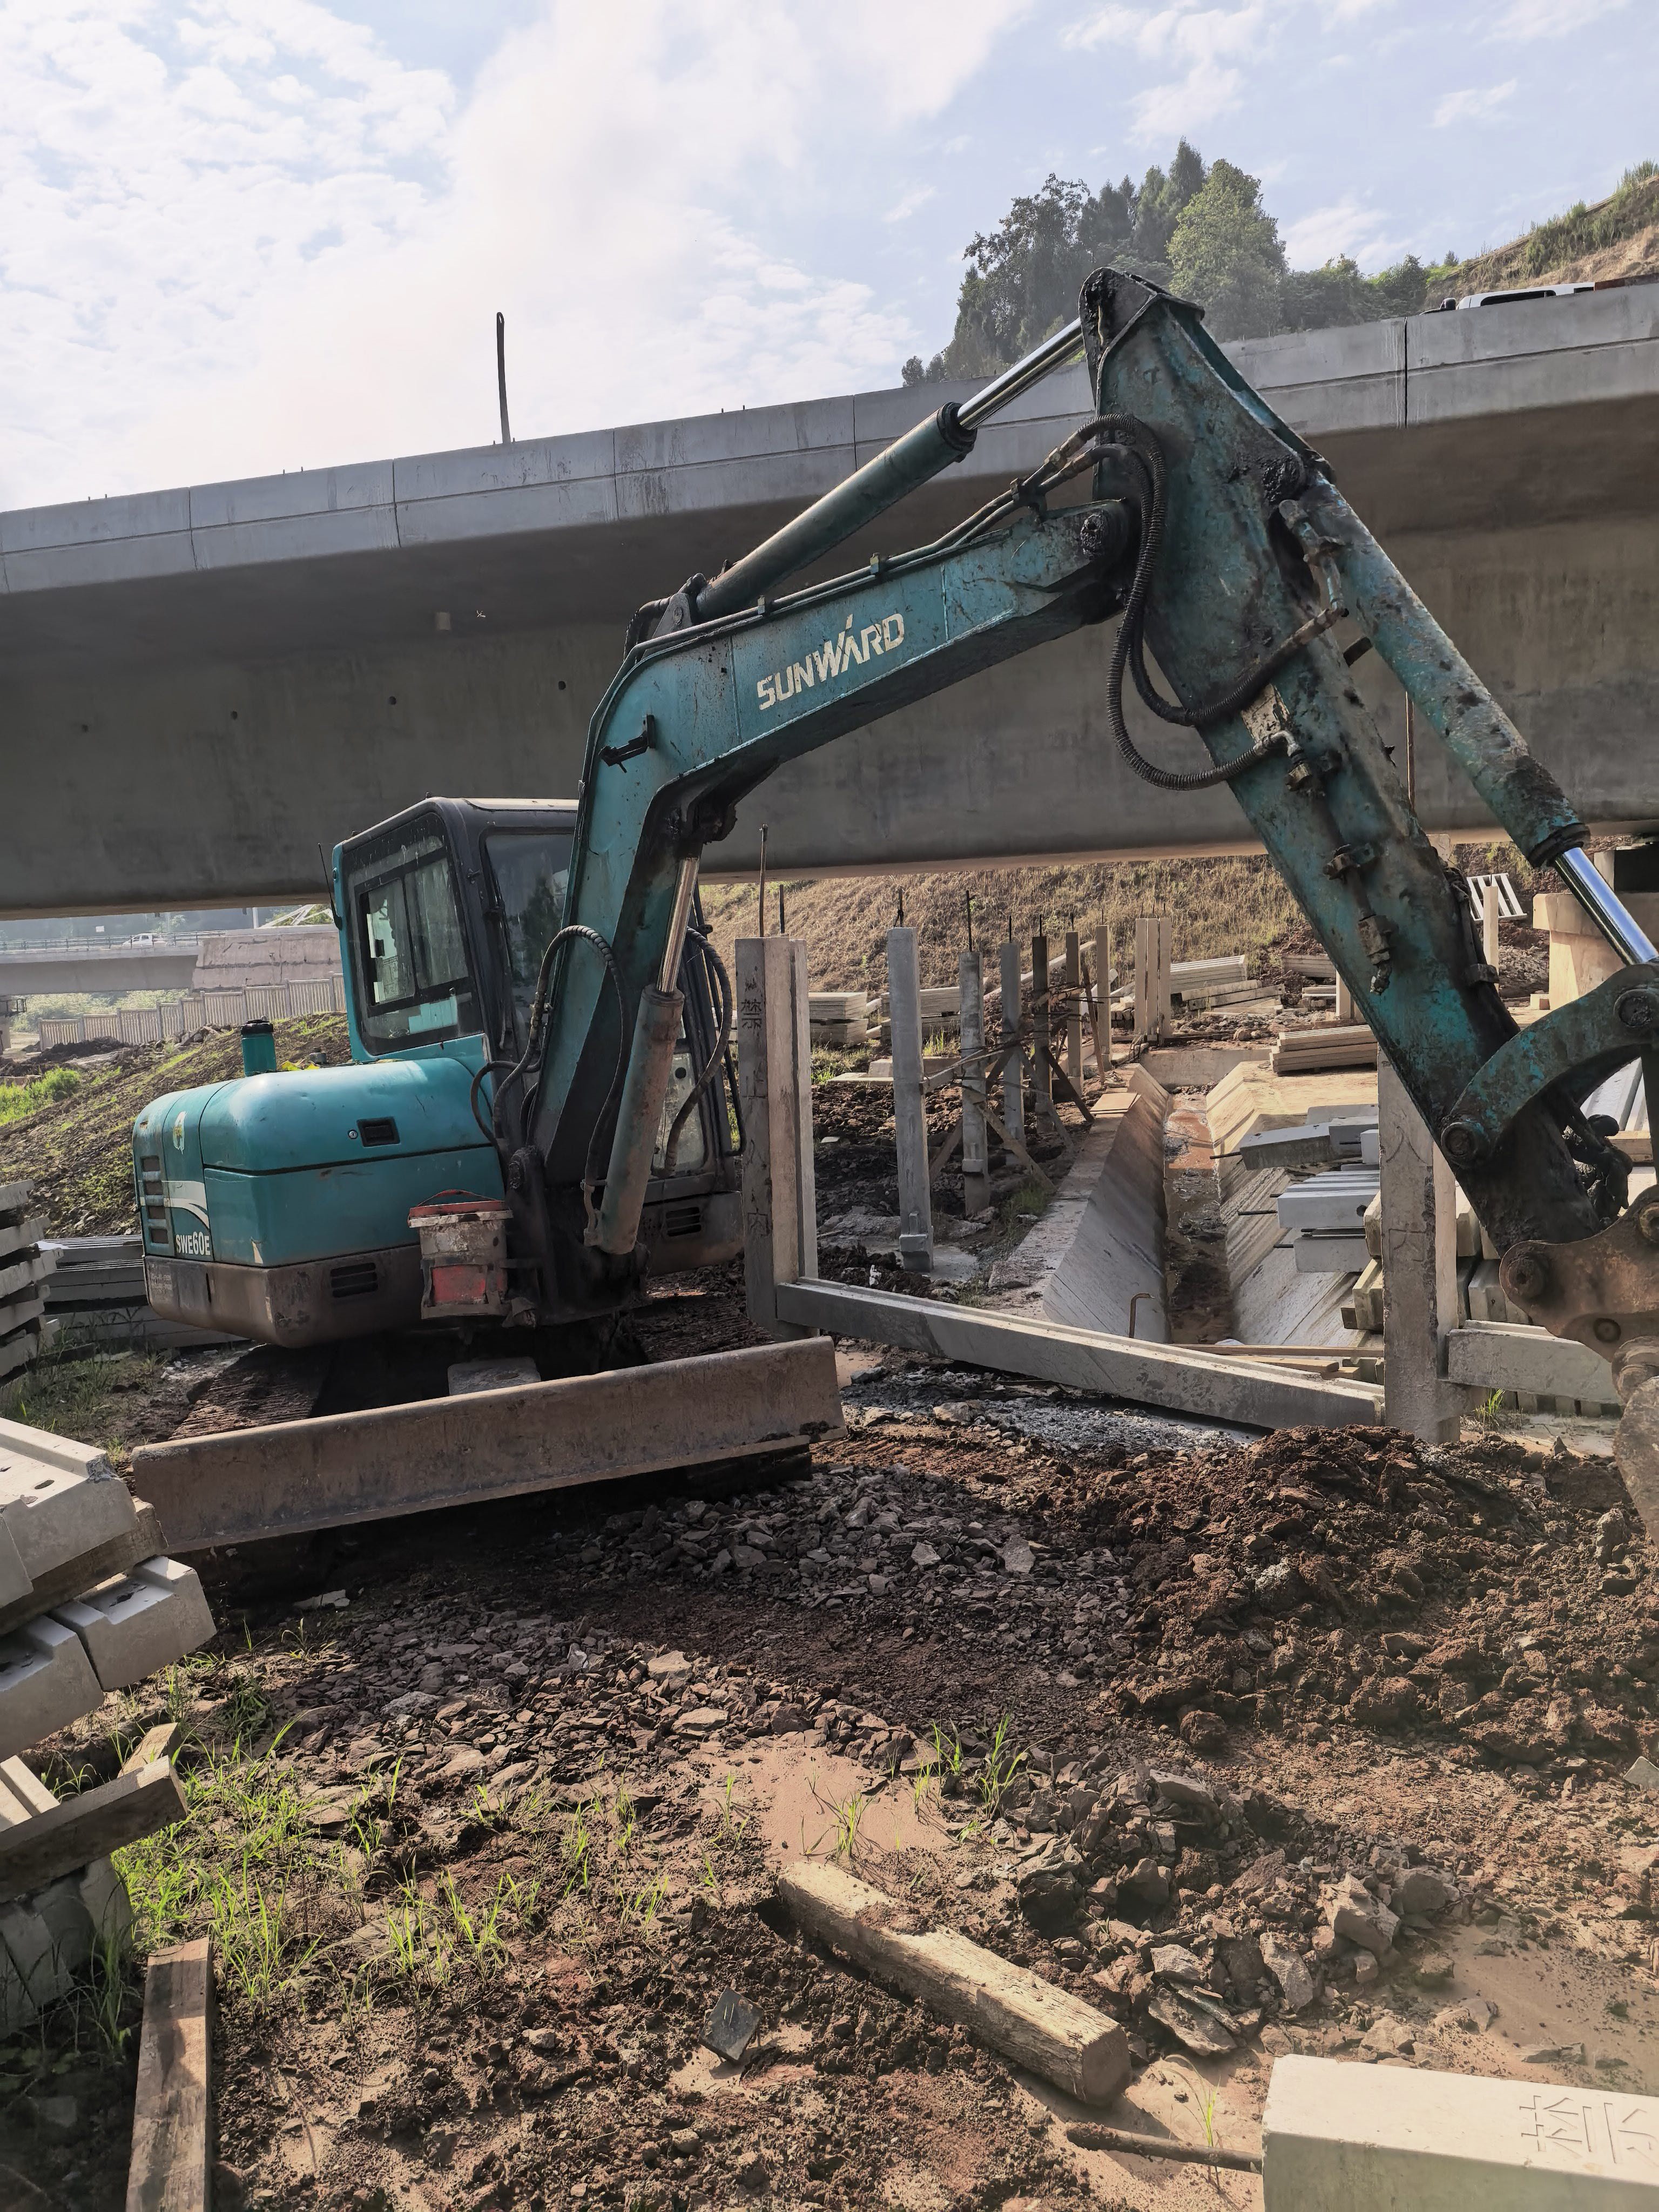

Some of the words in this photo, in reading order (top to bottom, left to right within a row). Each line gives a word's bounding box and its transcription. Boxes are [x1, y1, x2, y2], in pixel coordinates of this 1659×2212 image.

[757, 613, 905, 710] SUNWARD
[176, 1231, 211, 1256] SWE60E
[1519, 2095, 1659, 2167] 禁
